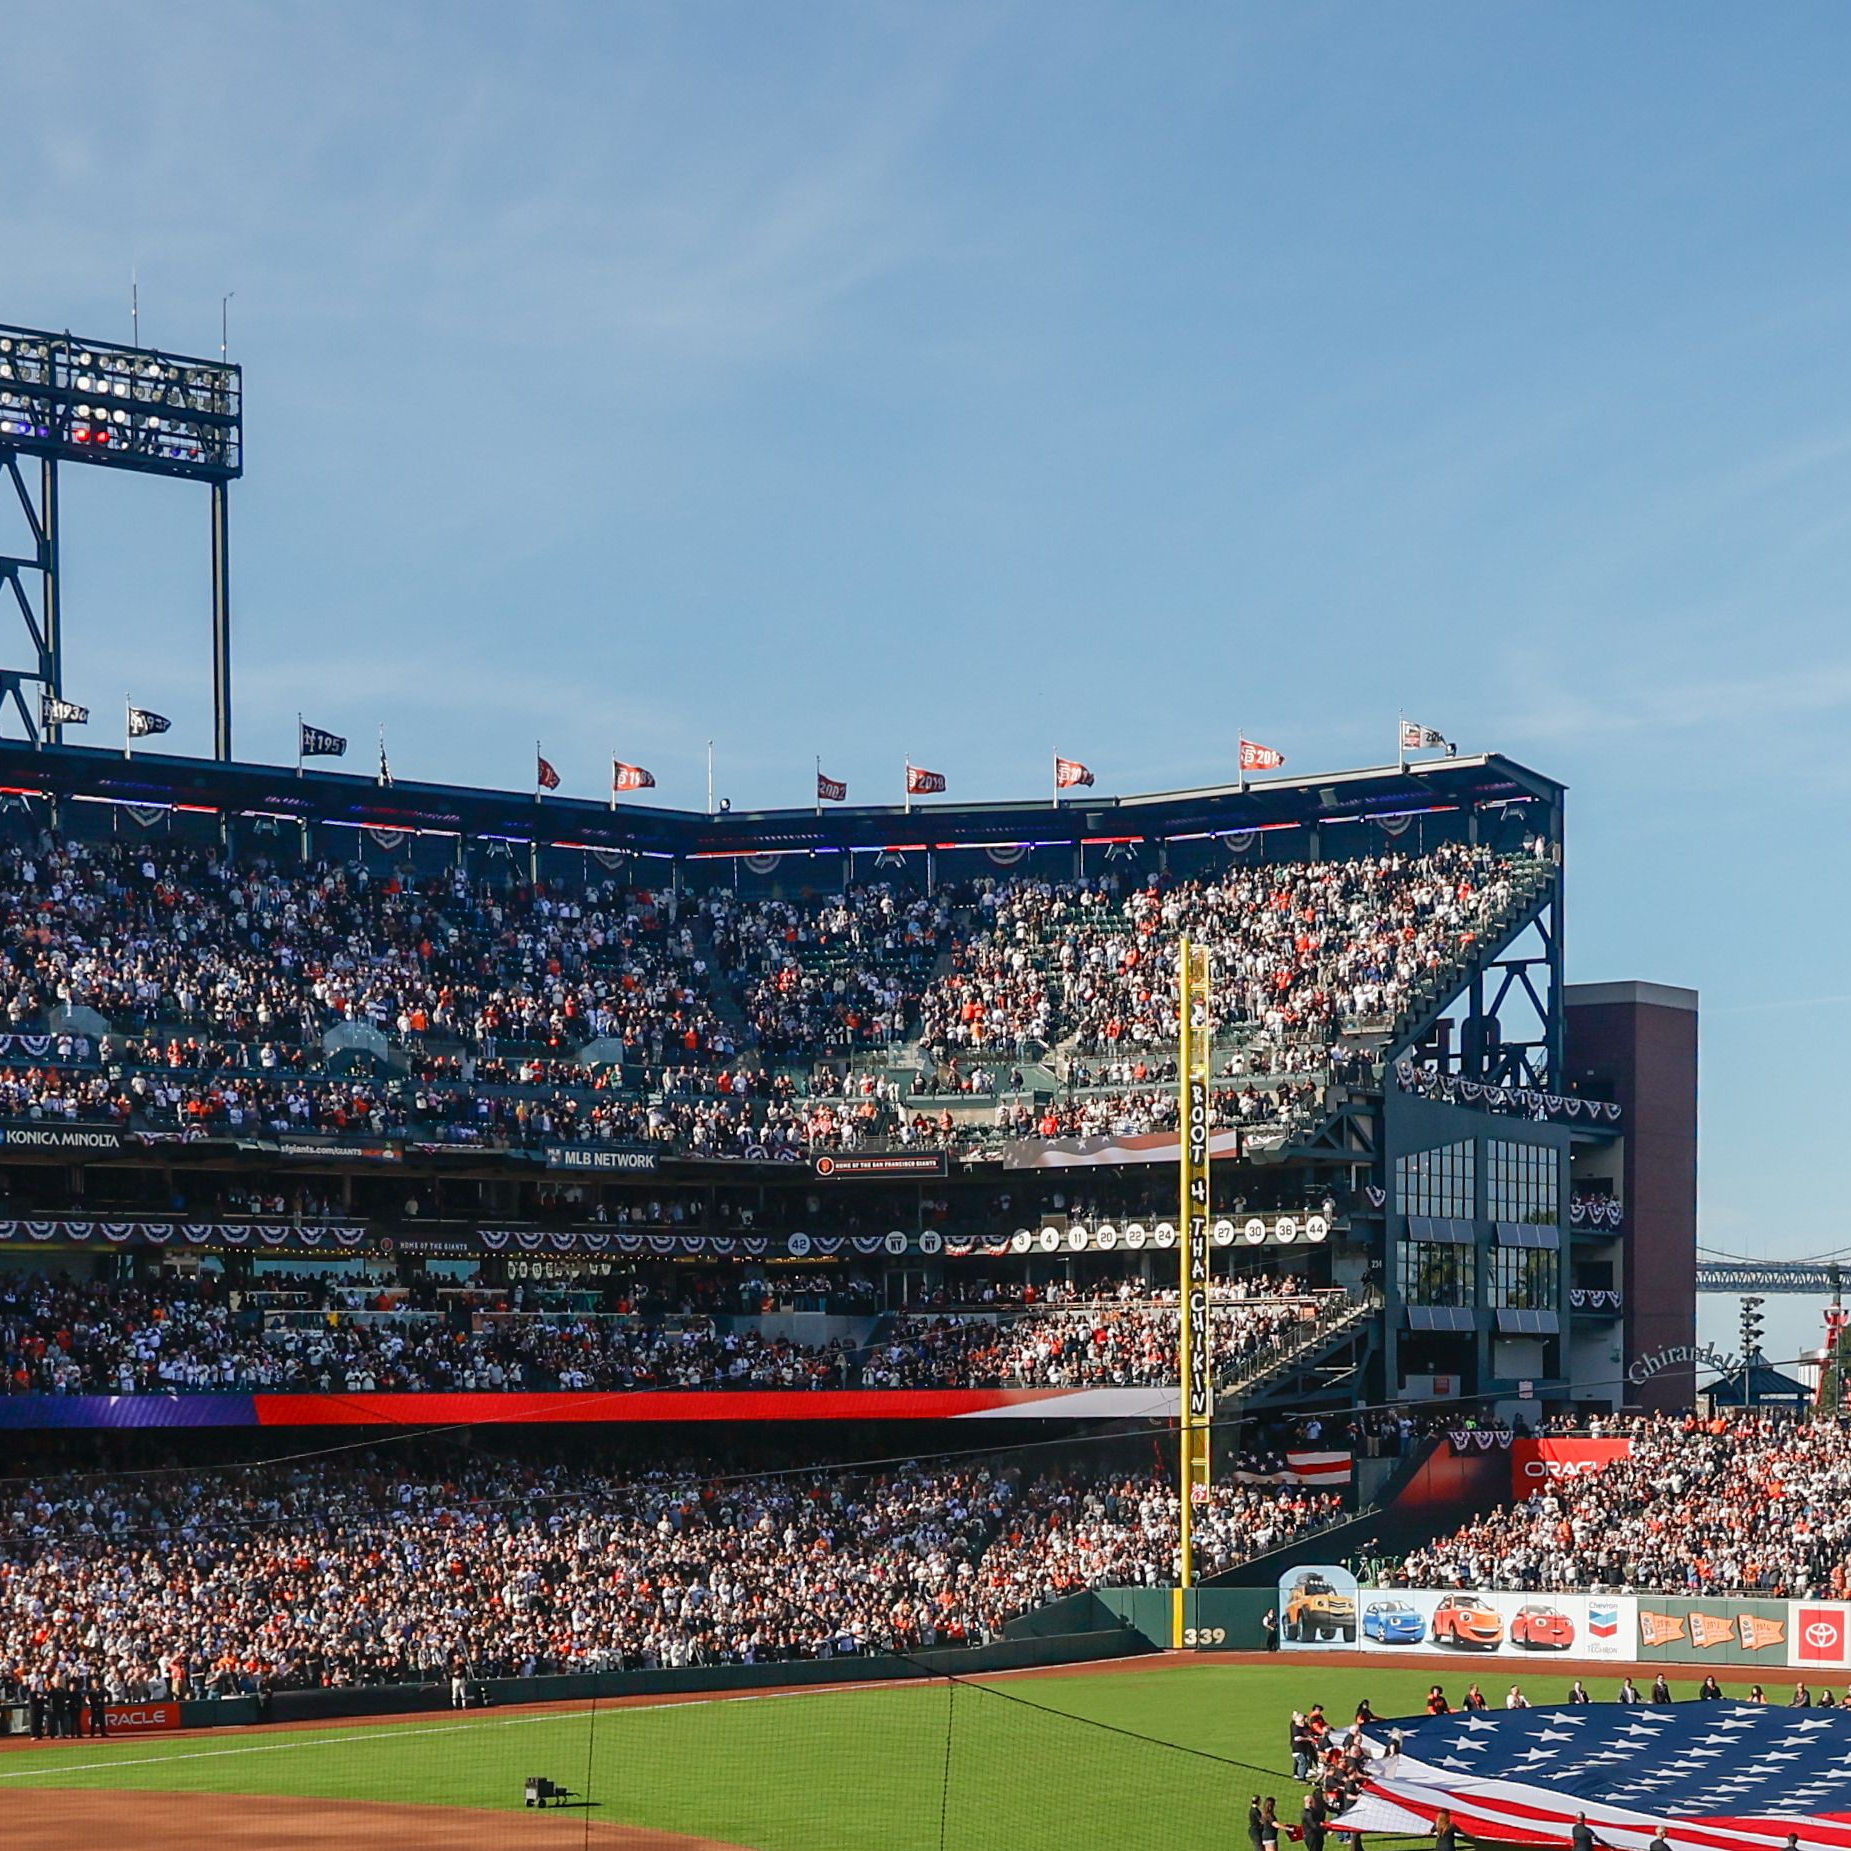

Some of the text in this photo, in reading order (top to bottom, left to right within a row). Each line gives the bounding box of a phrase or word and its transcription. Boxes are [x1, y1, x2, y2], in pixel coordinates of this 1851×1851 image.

[1191, 1085, 1206, 1163] ROOT
[6, 1130, 120, 1148] KONICA MINOLTA
[565, 1151, 592, 1165] MLB
[594, 1153, 654, 1168] NETWORK
[884, 1160, 915, 1168] FRANCISCO
[1191, 1181, 1205, 1201] 4
[1217, 1227, 1230, 1238] 27
[1248, 1226, 1262, 1237] 30
[1279, 1225, 1292, 1236] 36
[1309, 1223, 1323, 1234] 44
[1018, 1235, 1025, 1246] 3
[1045, 1234, 1052, 1244] 4
[1073, 1233, 1082, 1244] 11
[1100, 1232, 1113, 1243] 20
[1129, 1231, 1142, 1242] 22
[1158, 1230, 1171, 1241] 24
[400, 1242, 418, 1250] HOME
[419, 1242, 429, 1250] OF
[443, 1243, 468, 1251] GIANTS
[791, 1239, 807, 1250] 42
[1191, 1218, 1205, 1279] THA
[1190, 1293, 1205, 1412] CHIKIN
[1524, 1461, 1598, 1478] ORAC
[1589, 1601, 1618, 1609] Chevron
[1184, 1628, 1226, 1645] 339
